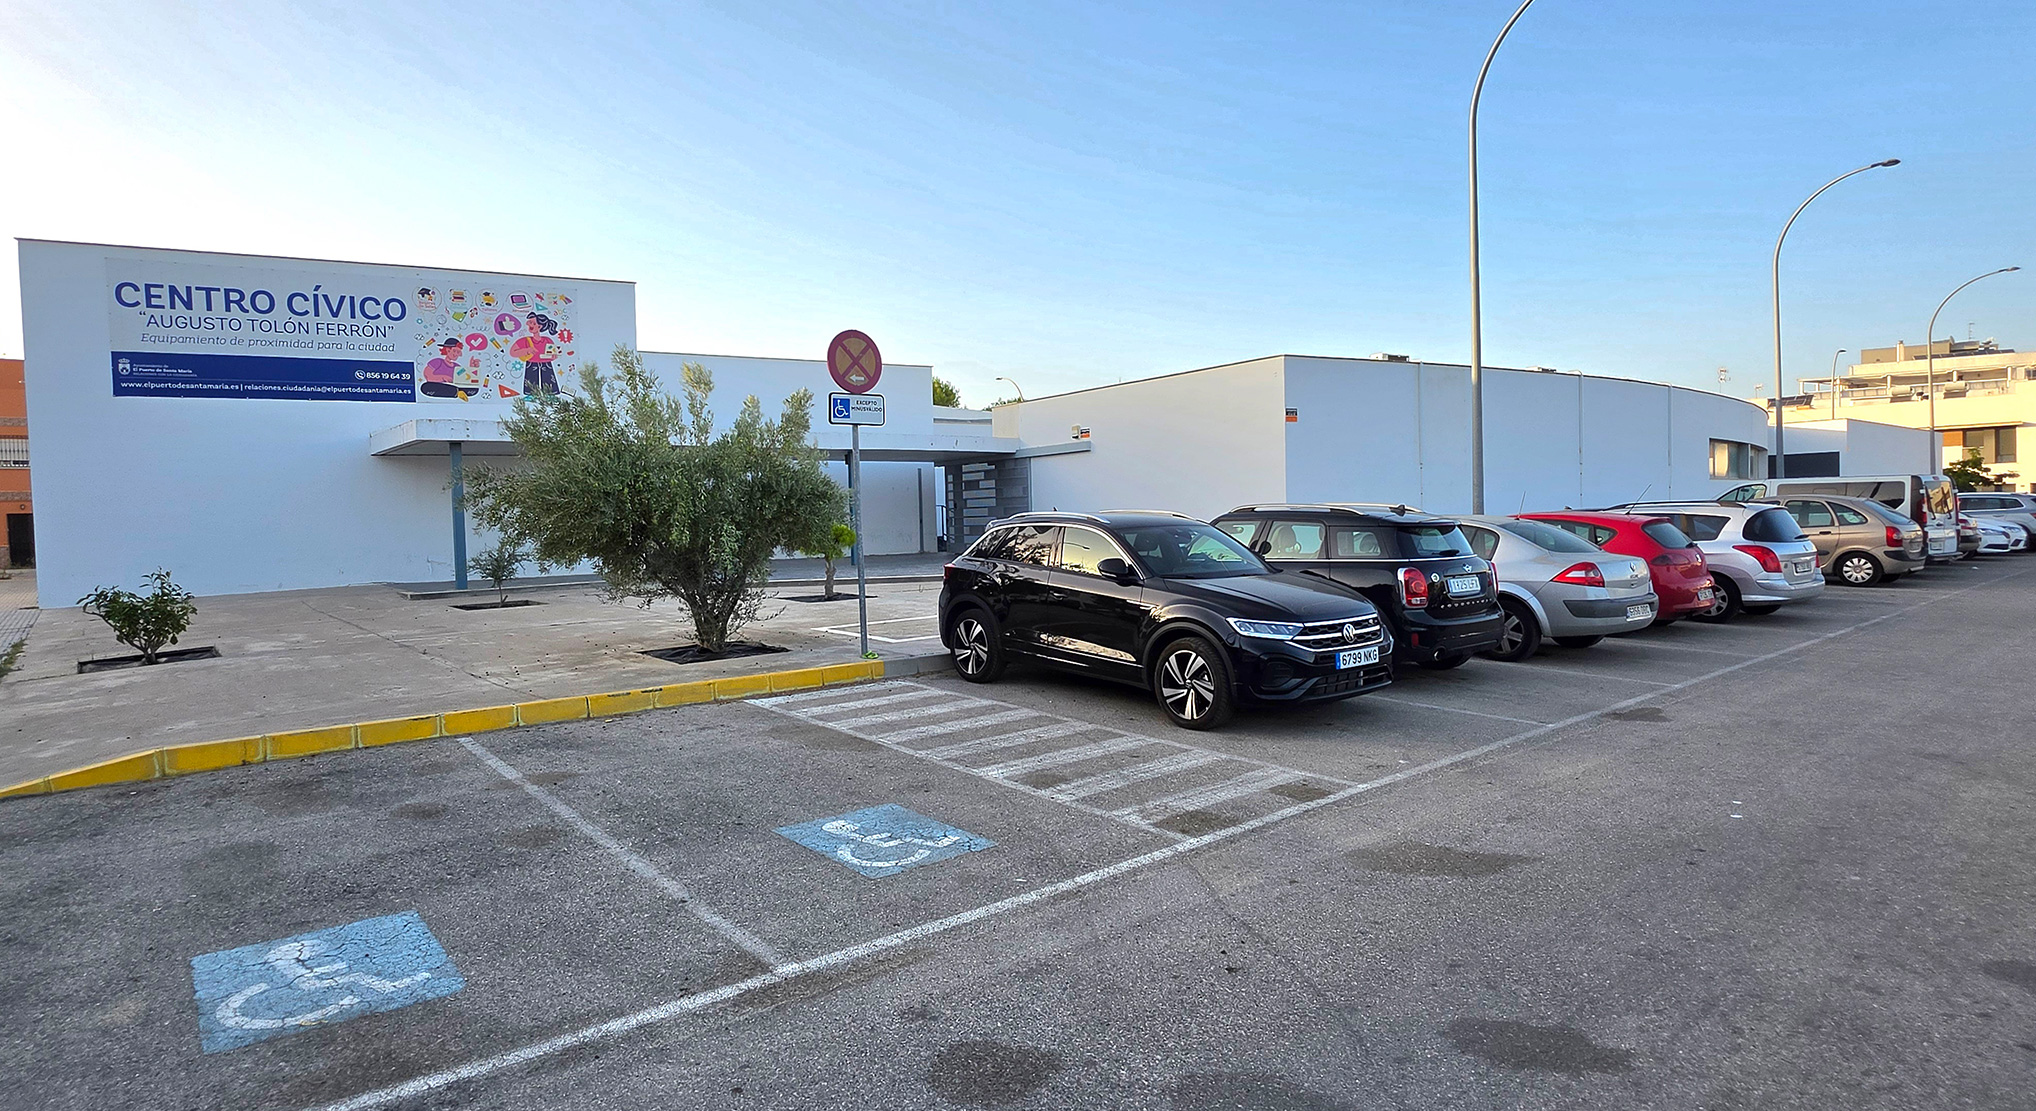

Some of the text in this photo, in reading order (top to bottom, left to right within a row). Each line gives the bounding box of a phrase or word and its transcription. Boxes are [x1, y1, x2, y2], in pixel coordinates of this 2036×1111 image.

[114, 281, 407, 322] CENTRO CÍVICO
[246, 316, 310, 335] TOLÓN
[140, 333, 395, 352] Equipamiento de proximidad para la ciudad
[1341, 649, 1378, 666] 6799 NKG
